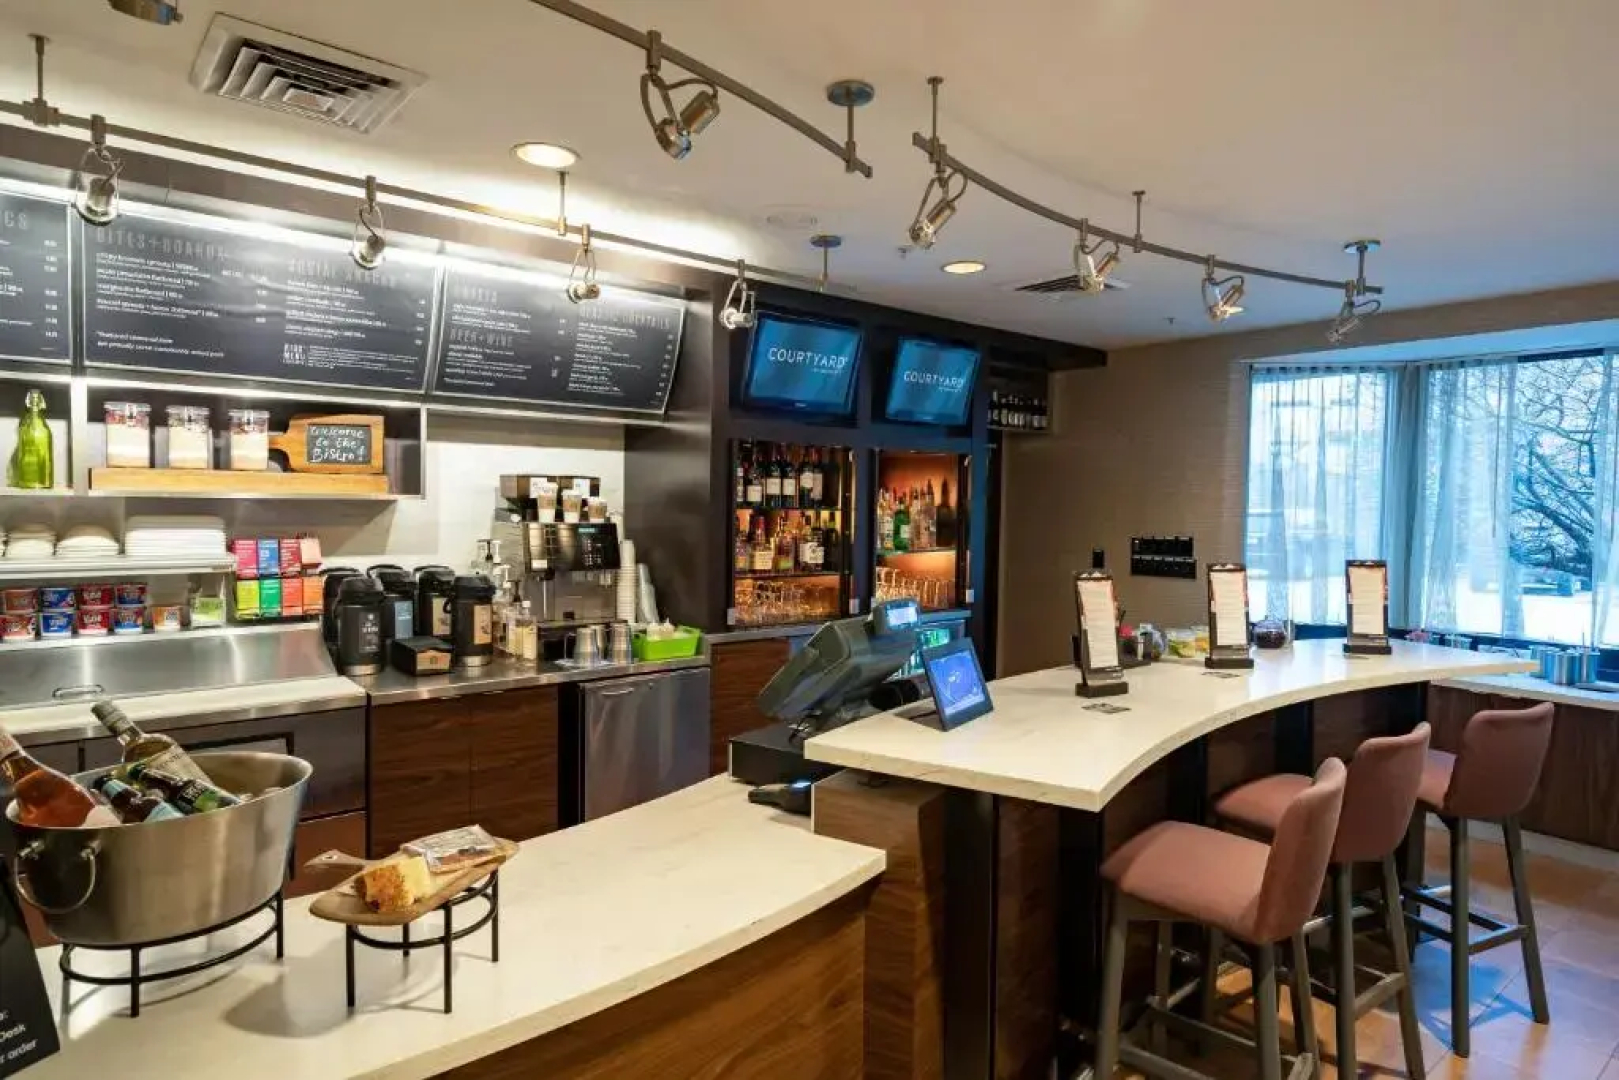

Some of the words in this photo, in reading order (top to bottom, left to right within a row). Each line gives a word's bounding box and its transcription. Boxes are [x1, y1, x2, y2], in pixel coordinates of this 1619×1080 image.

[768, 347, 847, 370] COURTYARD
[903, 371, 965, 389] COURTYARD
[8, 1038, 38, 1059] order
